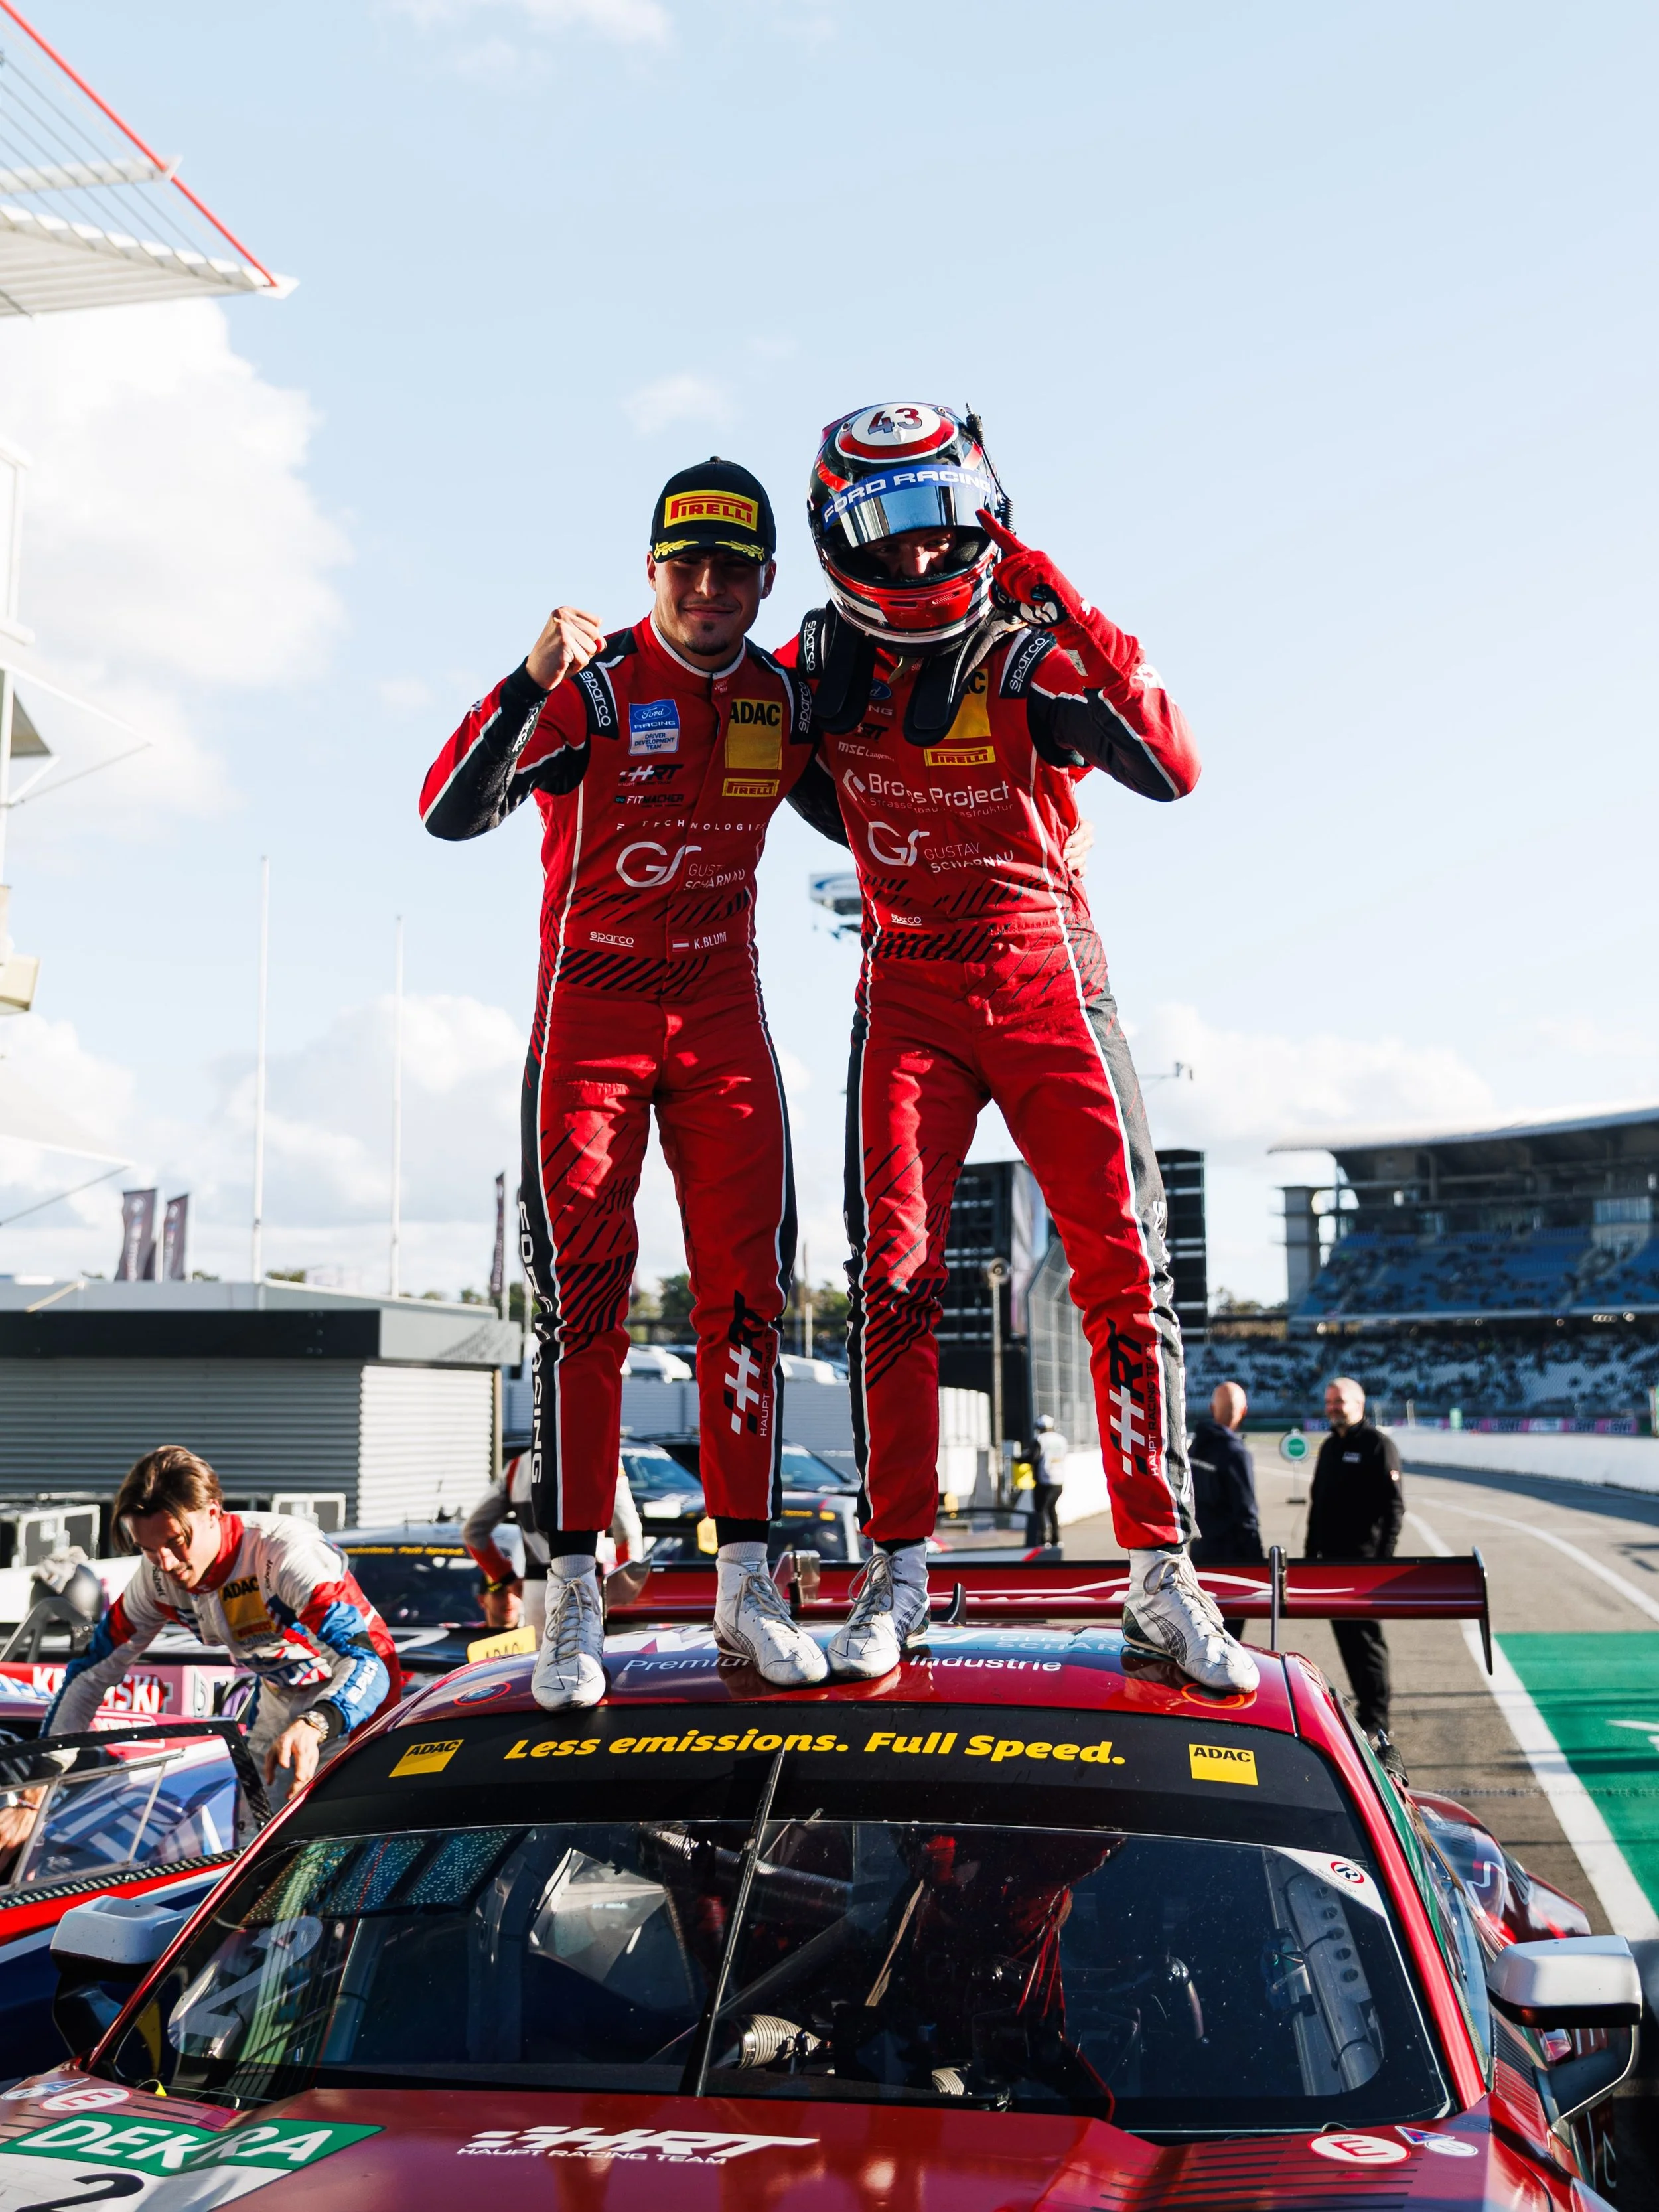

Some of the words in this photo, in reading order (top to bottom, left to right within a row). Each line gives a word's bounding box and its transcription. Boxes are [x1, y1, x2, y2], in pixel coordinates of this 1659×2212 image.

[868, 408, 922, 435] 43
[824, 479, 887, 523] FORD
[894, 470, 991, 494] RACING
[670, 495, 753, 524] PIRELLI
[804, 620, 816, 673] sparco
[1009, 638, 1050, 692] sparco
[579, 670, 611, 727] sparco
[798, 681, 812, 733] sparco
[642, 707, 664, 719] Ford
[730, 701, 780, 727] ADAC
[634, 721, 676, 729] RACING
[634, 737, 675, 746] DEVELOPMENT
[930, 749, 988, 764] PIRELLI
[726, 782, 777, 795] PIRELLI
[929, 780, 1009, 810] Project
[924, 842, 981, 861] GUSTAV
[930, 850, 1014, 873] SCHARNAU
[683, 869, 745, 891] SCHARNAU
[891, 913, 922, 926] sparco
[590, 931, 634, 948] sparco
[694, 931, 727, 950] K.BLUM
[760, 1393, 770, 1436] HAUPT
[1147, 1381, 1157, 1430] RACING
[1147, 1434, 1159, 1477] HAUPT
[222, 1576, 259, 1601] ADAC
[910, 1655, 1062, 1672] Industrie
[407, 1740, 461, 1757] ADAC
[504, 1739, 601, 1760] Less
[608, 1729, 849, 1753] emissions.
[863, 1732, 958, 1755] Full
[964, 1733, 1125, 1765] Speed.
[1193, 1745, 1252, 1763] ADAC
[15, 2119, 334, 2168] DEKRA
[1329, 2139, 1390, 2157] E
[457, 2147, 545, 2156] HAUPT
[548, 2149, 648, 2161] RACING
[656, 2153, 727, 2165] TEAM
